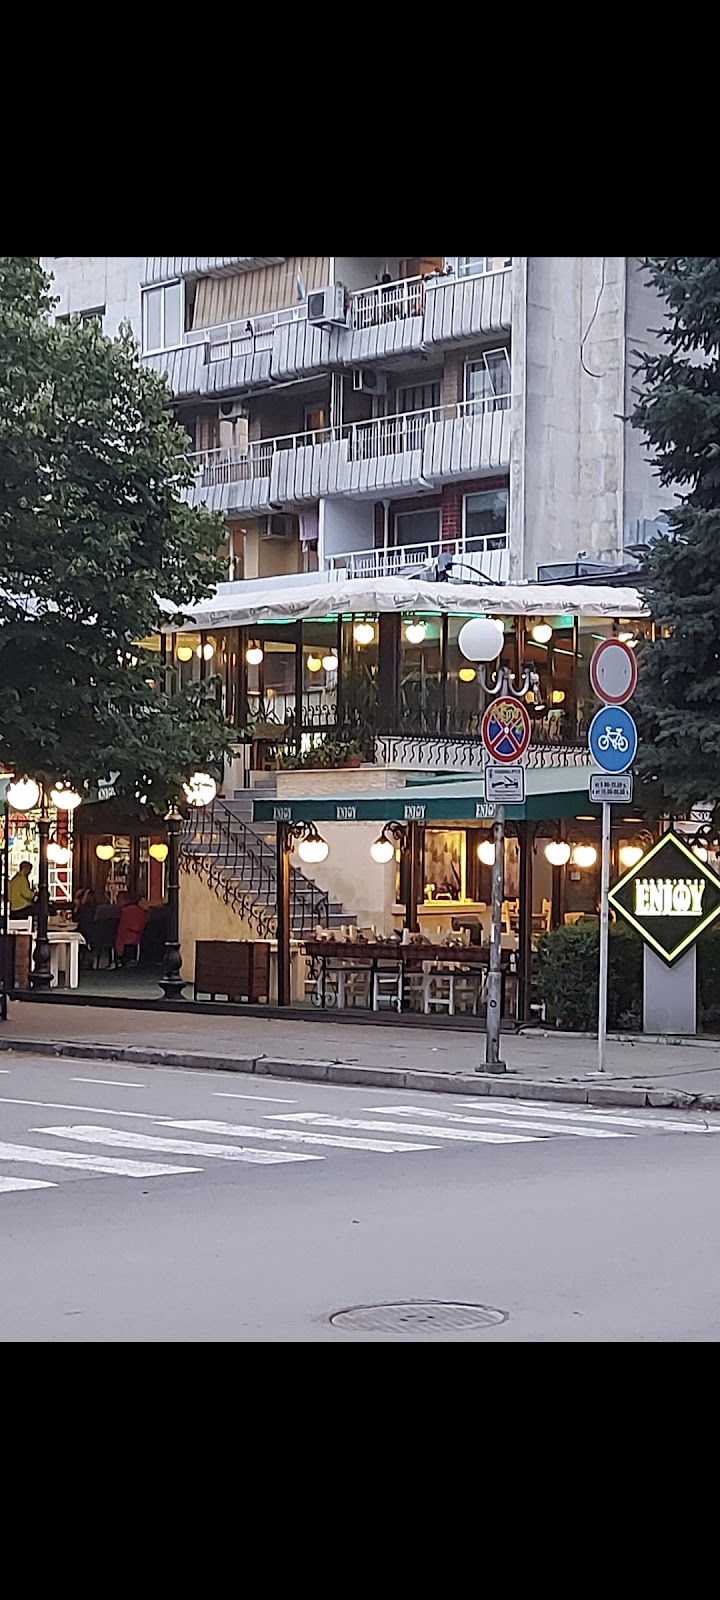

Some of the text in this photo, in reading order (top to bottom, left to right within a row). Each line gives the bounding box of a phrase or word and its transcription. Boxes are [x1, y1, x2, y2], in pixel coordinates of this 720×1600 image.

[273, 807, 292, 820] ENJOY
[336, 806, 357, 819] ENJOY
[404, 805, 426, 819] ENJOY
[475, 803, 497, 818] ENJO
[634, 881, 706, 917] ENJOY
